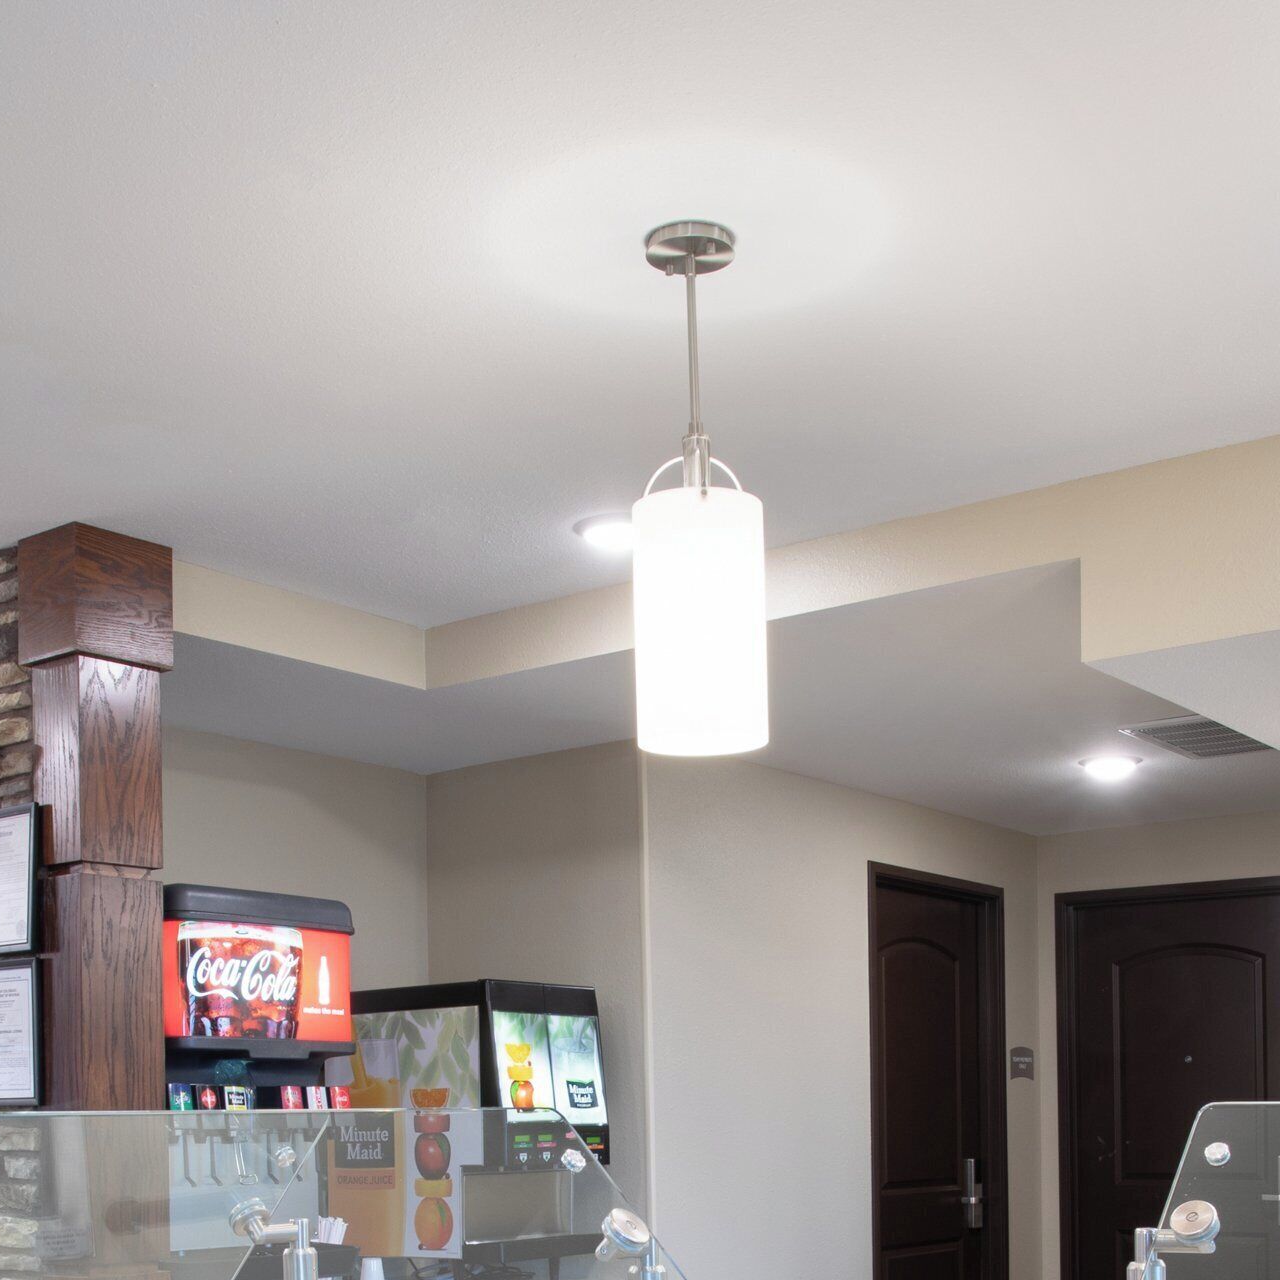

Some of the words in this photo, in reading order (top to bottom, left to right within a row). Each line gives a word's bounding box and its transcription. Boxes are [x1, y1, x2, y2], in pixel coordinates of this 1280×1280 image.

[186, 946, 300, 1002] Coca-Cola
[340, 1126, 389, 1142] Minute
[346, 1143, 383, 1160] Maid
[337, 1175, 369, 1185] ORANGE
[369, 1175, 393, 1185] JUICE
